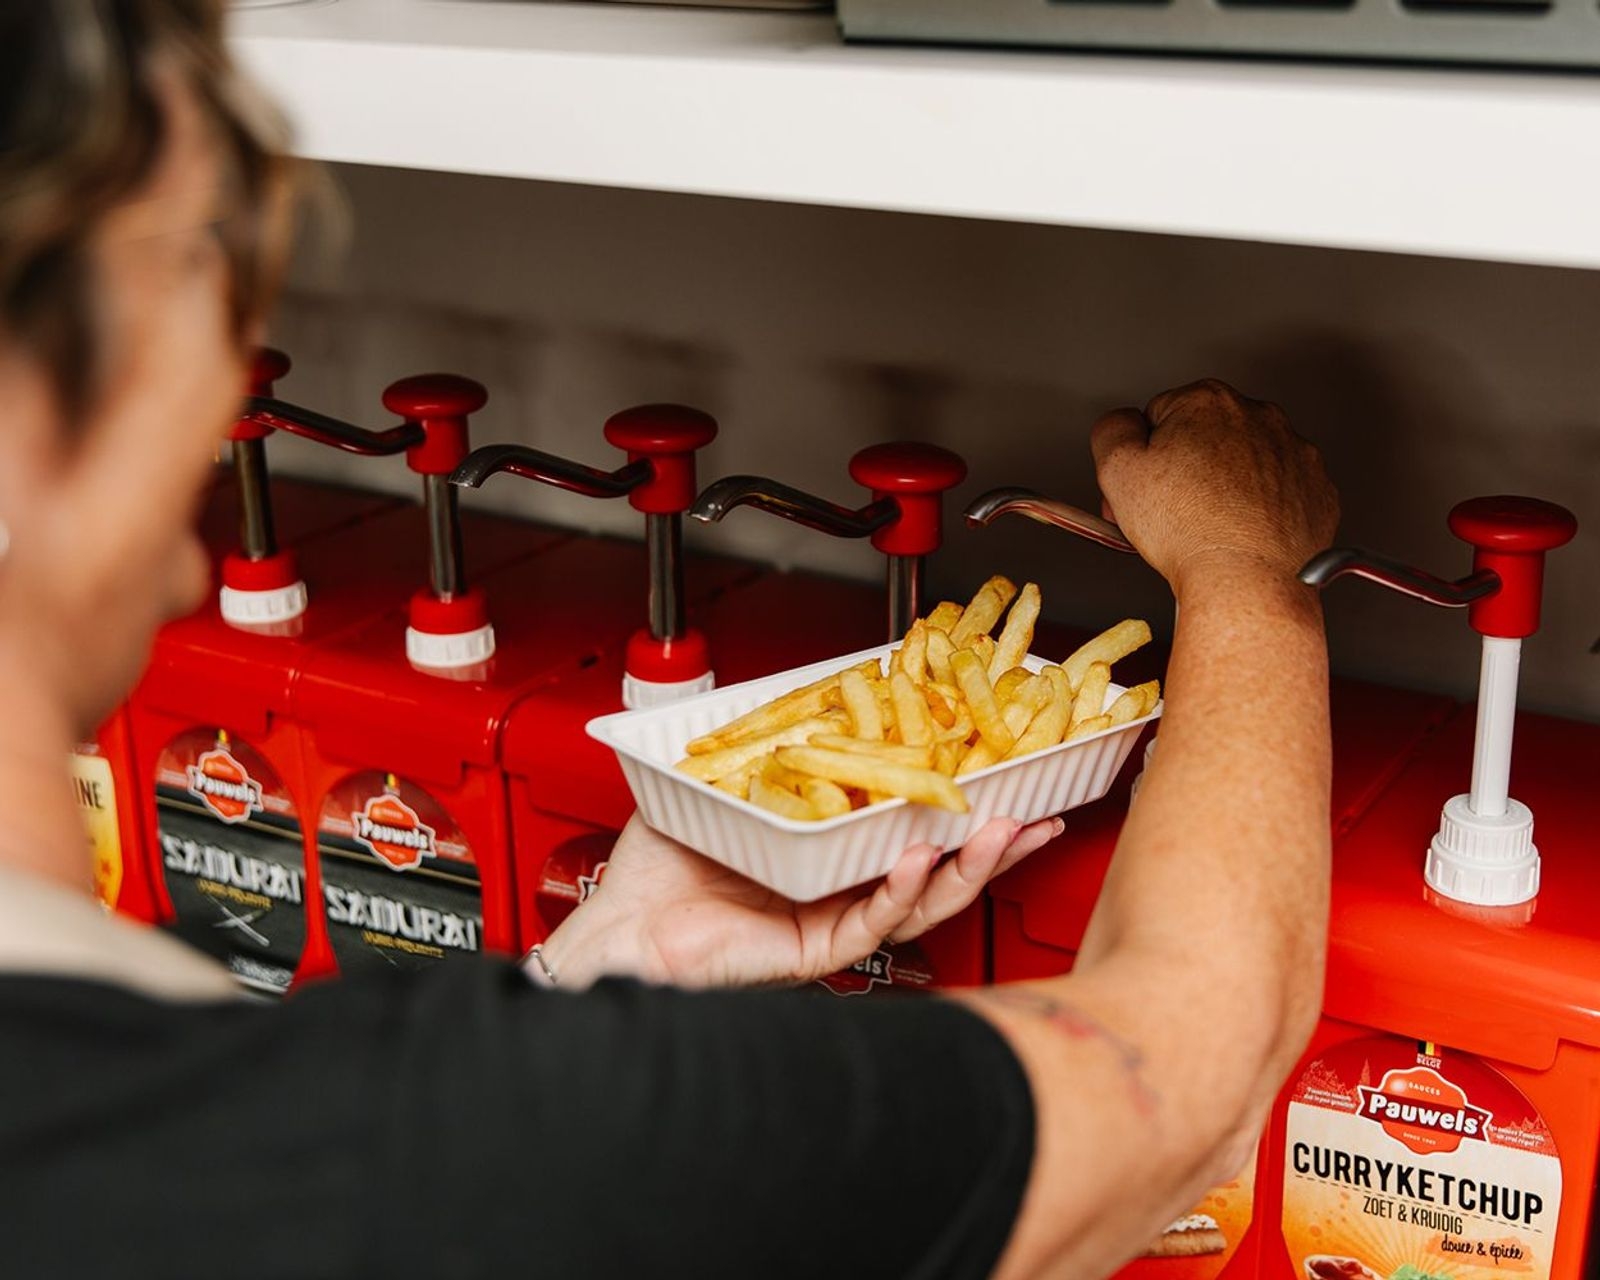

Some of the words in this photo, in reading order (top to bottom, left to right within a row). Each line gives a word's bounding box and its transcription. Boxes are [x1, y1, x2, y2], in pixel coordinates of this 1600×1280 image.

[195, 770, 256, 803] Pauwels
[361, 818, 428, 849] Pauwels
[162, 833, 302, 904] SAMURAI
[325, 885, 477, 951] SAMURAI
[1408, 1081, 1441, 1096] SAUCES
[1369, 1093, 1479, 1135] Pauwels
[1293, 1142, 1543, 1225] CURRYKETCHUP
[1363, 1196, 1394, 1219] ZOET
[1397, 1204, 1407, 1222] &
[1411, 1207, 1463, 1235] KRUIDIG
[1441, 1234, 1474, 1255] douce
[1476, 1243, 1487, 1256] &
